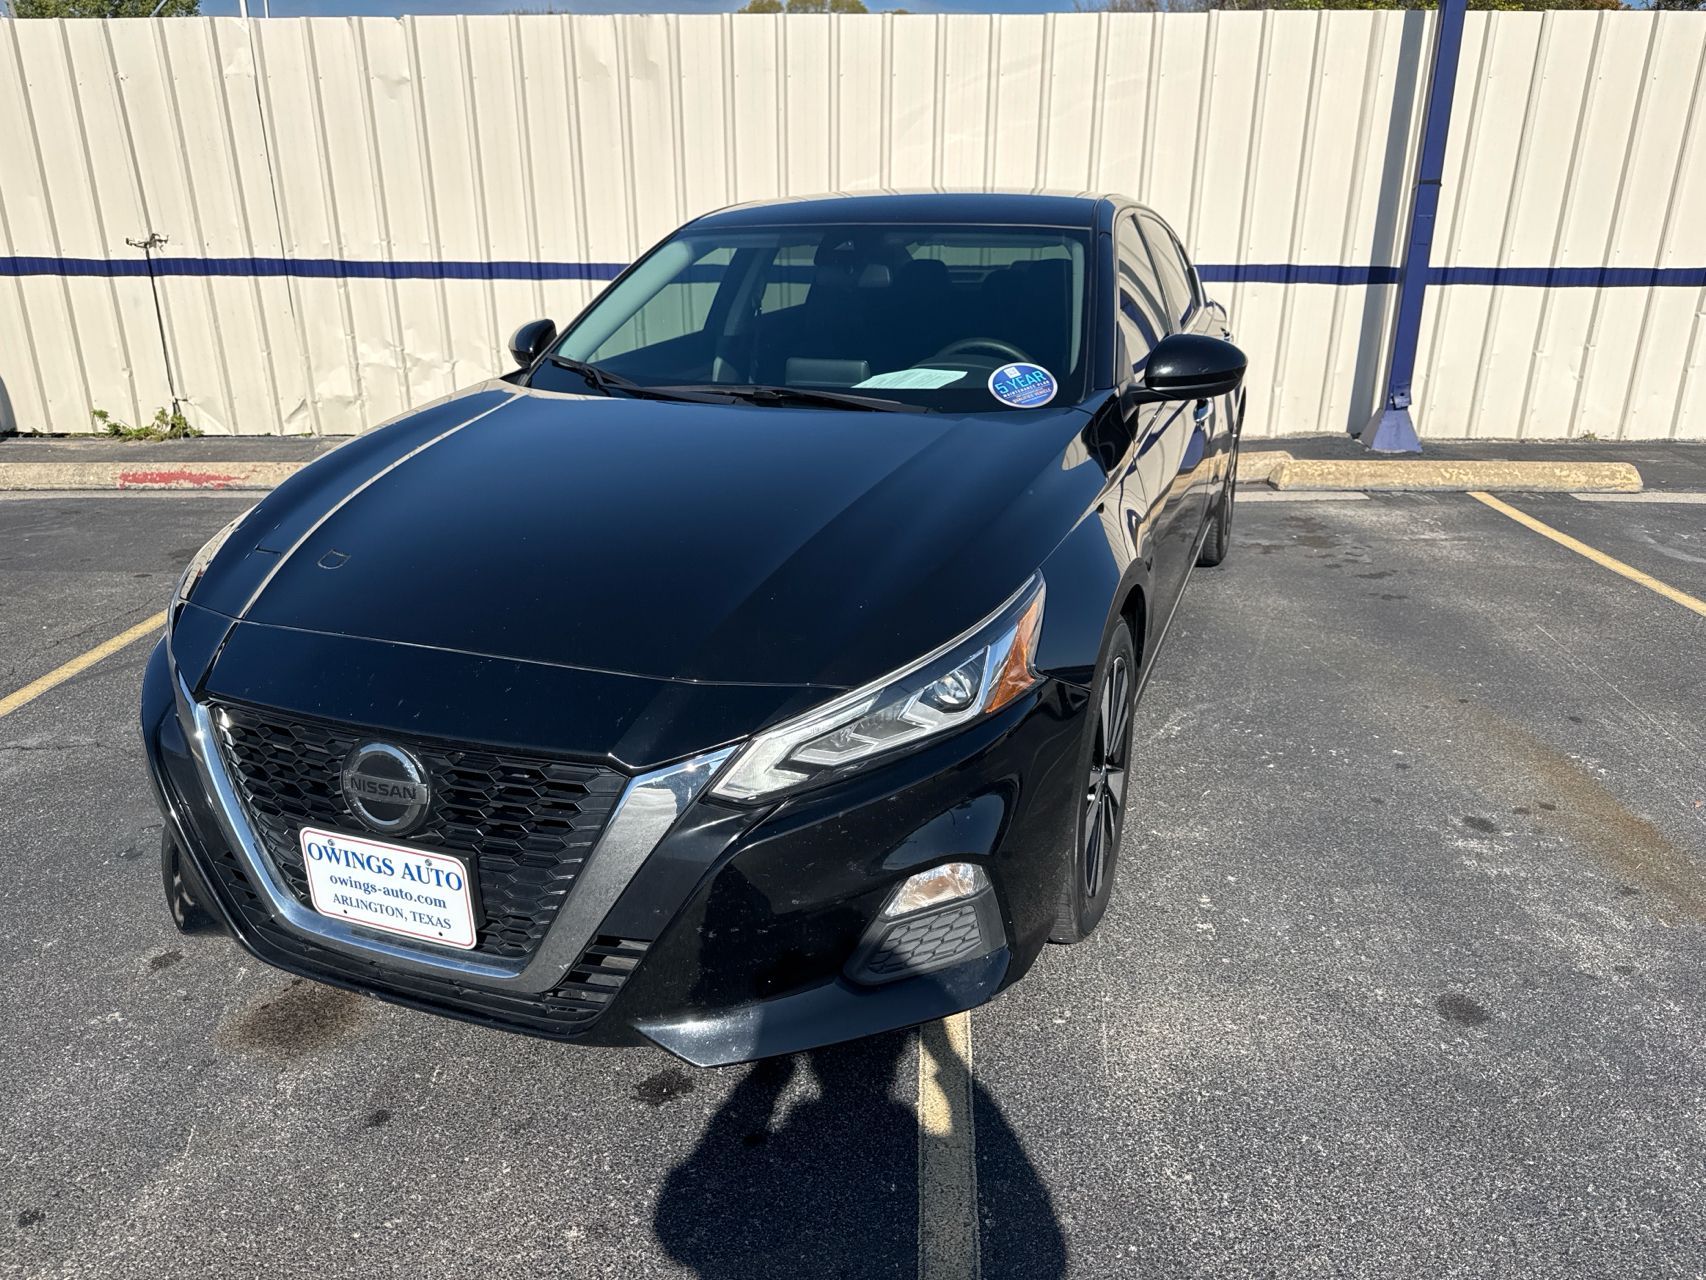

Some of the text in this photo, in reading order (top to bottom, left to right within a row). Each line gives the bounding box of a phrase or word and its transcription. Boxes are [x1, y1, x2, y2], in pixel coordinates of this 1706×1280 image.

[995, 382, 1009, 394] 5
[1006, 370, 1047, 389] YEAR
[350, 777, 416, 799] NISSAN
[307, 841, 463, 892] OWINGS AUTO
[329, 874, 447, 909] owings-auto.com
[333, 892, 452, 930] ARLINGTON, TEXAS
